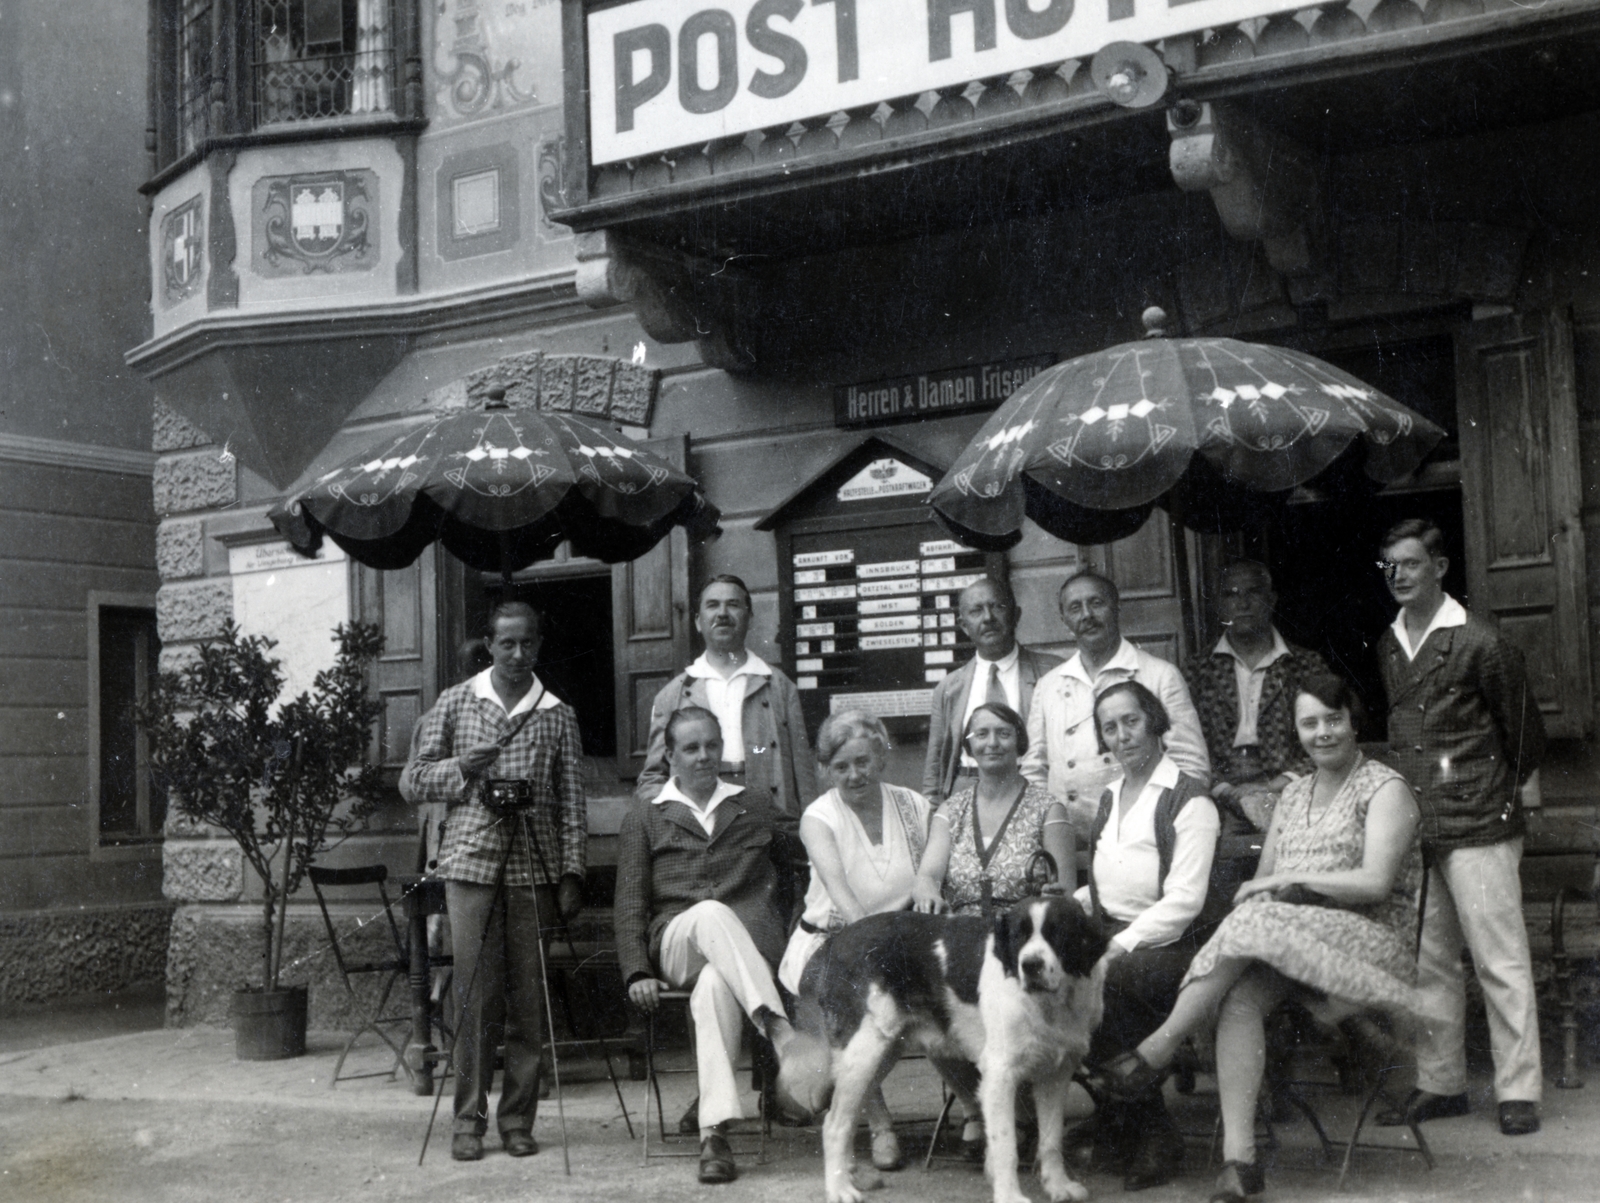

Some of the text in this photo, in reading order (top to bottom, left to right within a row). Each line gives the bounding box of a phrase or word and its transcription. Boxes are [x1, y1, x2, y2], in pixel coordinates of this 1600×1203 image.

[614, 0, 859, 133] POST
[848, 386, 899, 418] Herren
[903, 385, 914, 408] &
[918, 376, 976, 409] Damen
[798, 553, 848, 564] ANKUNFT VON
[865, 564, 911, 574] INNSBRUCK
[862, 584, 892, 593] OETZTAL
[877, 602, 899, 610] IMST
[865, 637, 915, 647] ZWIESELSTEIN
